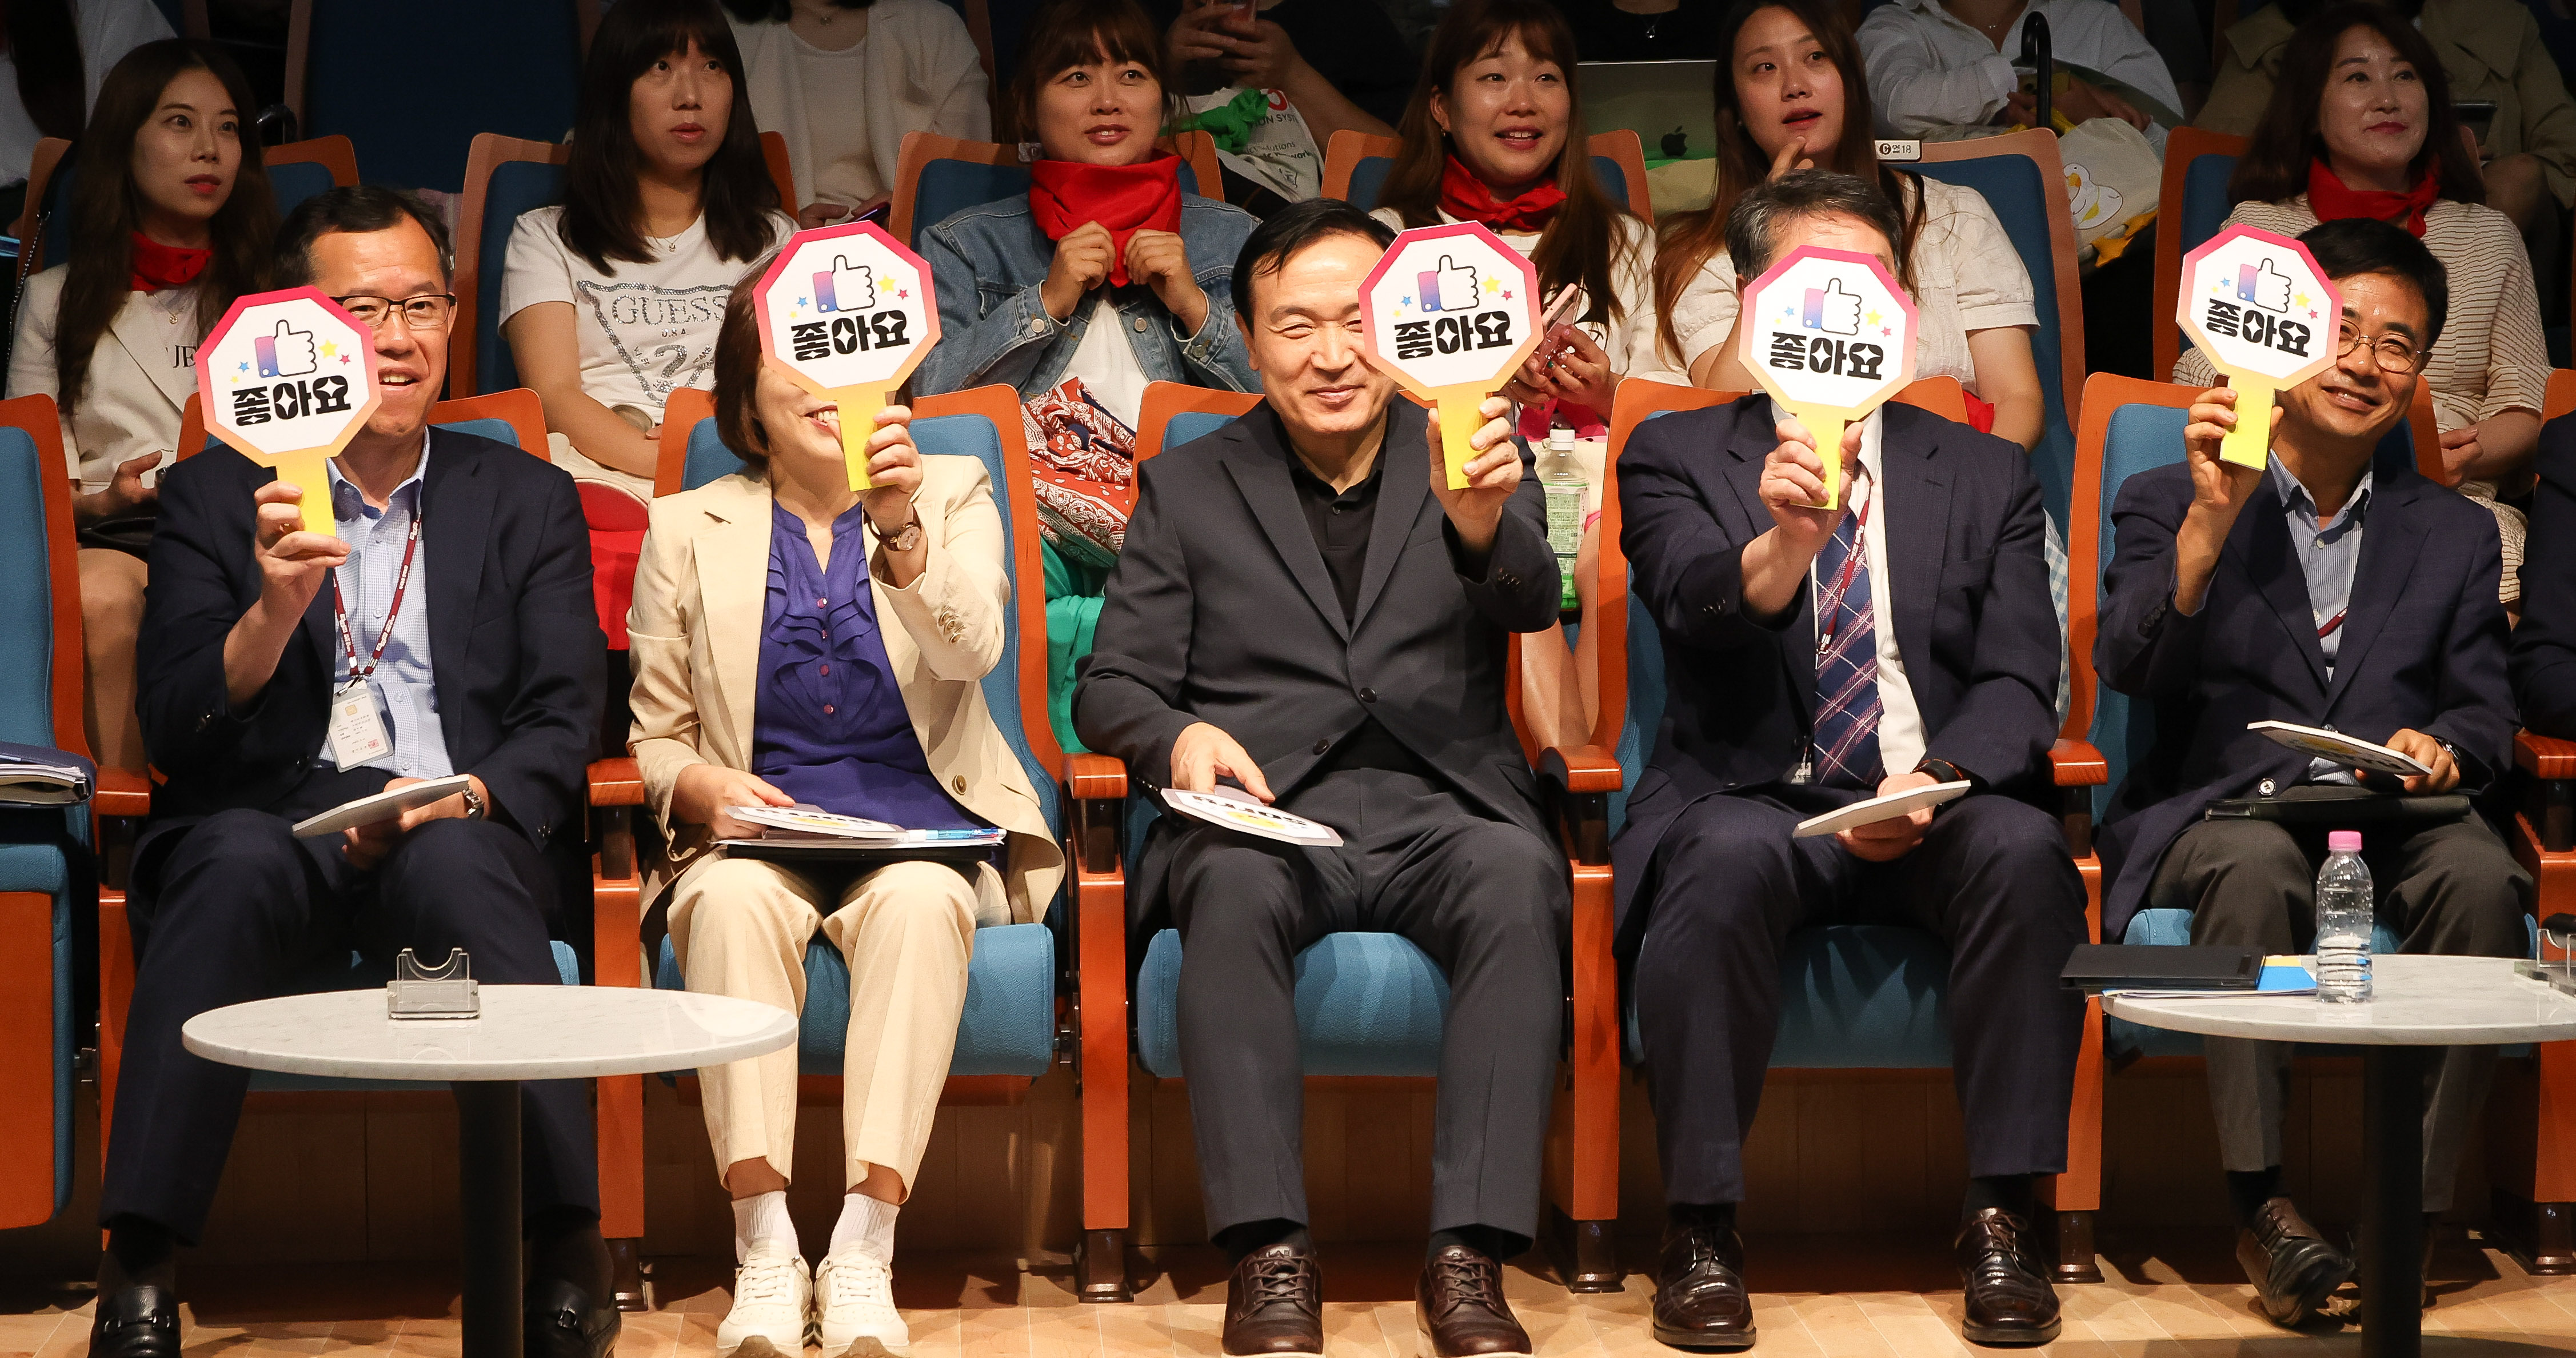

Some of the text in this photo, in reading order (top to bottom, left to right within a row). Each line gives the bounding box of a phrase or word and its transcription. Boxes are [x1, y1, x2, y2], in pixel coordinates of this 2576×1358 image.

[791, 310, 910, 361] 좋아요
[1394, 310, 1513, 360] 좋아요
[2206, 298, 2311, 358] 좋아요
[1770, 331, 1884, 381] 좋아요
[232, 375, 352, 426] 좋아요
